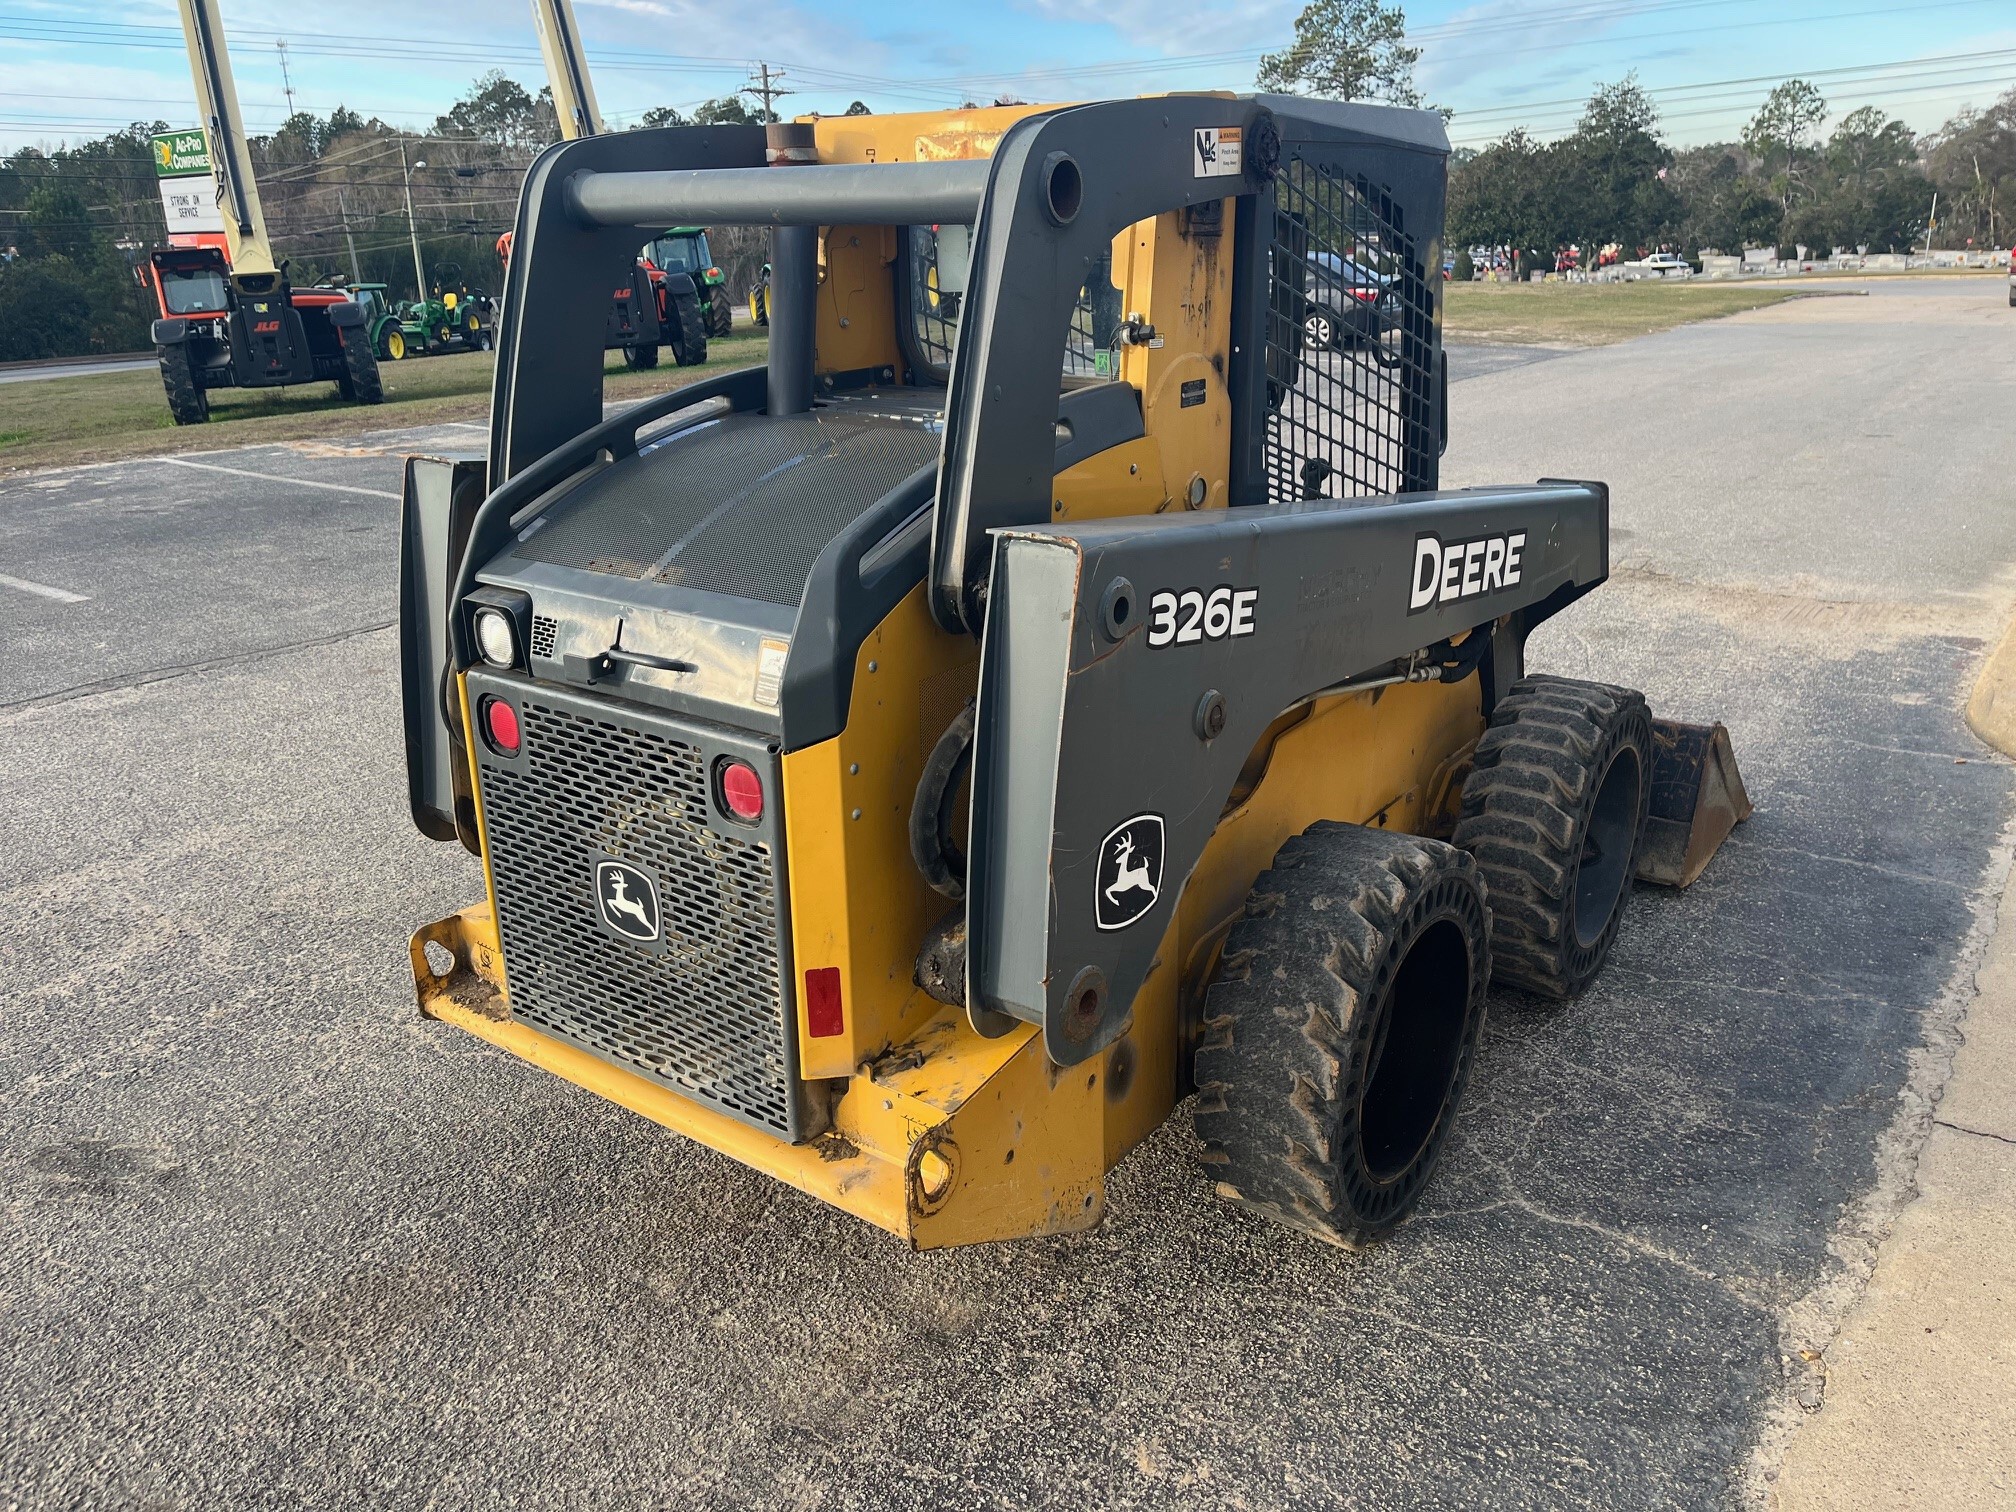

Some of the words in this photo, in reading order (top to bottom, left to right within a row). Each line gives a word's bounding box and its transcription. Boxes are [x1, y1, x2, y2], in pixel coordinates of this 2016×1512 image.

[170, 195, 189, 207] STRONG
[192, 194, 200, 204] ON
[178, 206, 199, 218] SERVICE
[254, 321, 279, 332] JLG
[1410, 533, 1526, 609] DEERE
[1148, 587, 1259, 646] 326E
